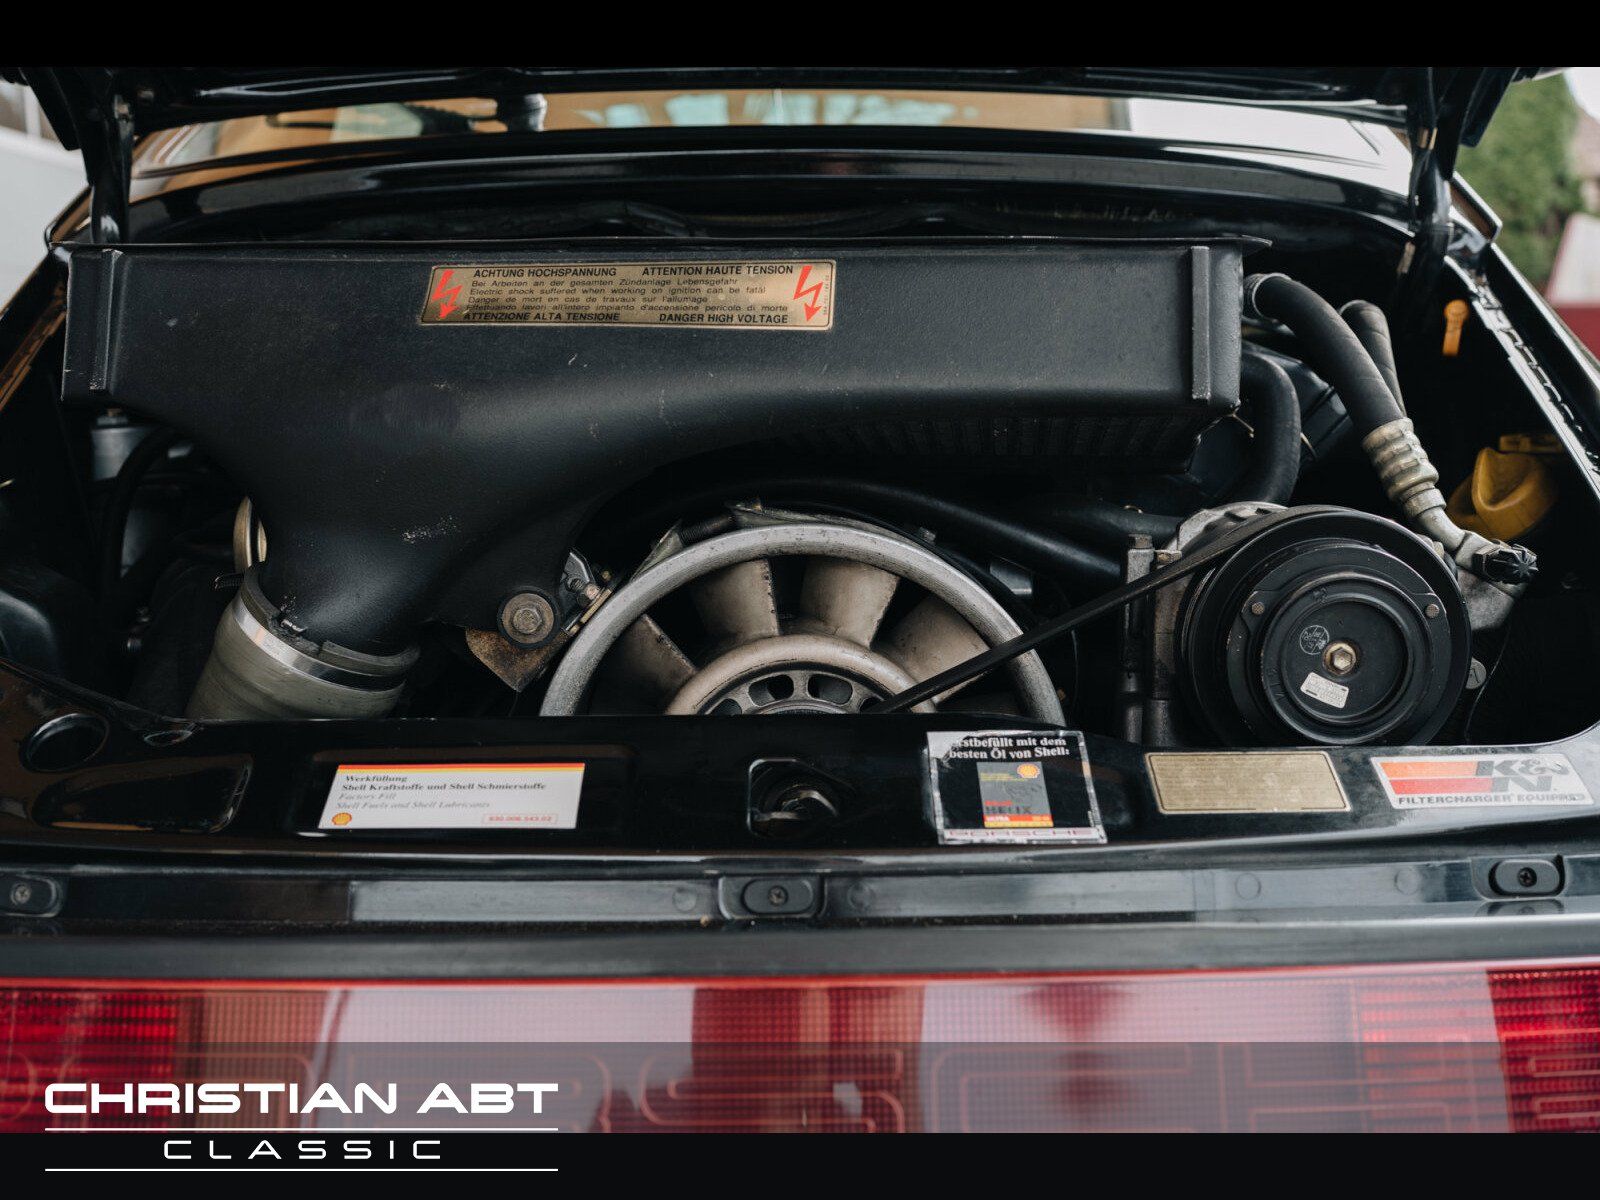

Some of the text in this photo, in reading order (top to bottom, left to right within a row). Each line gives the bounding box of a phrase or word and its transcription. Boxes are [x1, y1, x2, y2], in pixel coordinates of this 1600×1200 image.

[473, 267, 617, 278] ACHTUNG HOCHSPANNUNG
[642, 265, 793, 276] ATTENTION HAUTE TENSION
[550, 279, 565, 287] der
[570, 280, 614, 288] gesamten
[619, 278, 672, 287] Zündanlage
[677, 278, 738, 287] Lebensgefahr
[508, 287, 534, 295] shock
[540, 287, 577, 295] suffered
[611, 286, 646, 295] working
[668, 286, 701, 295] ignition
[729, 286, 740, 294] be
[468, 296, 500, 305] Danger
[586, 295, 597, 303] de
[602, 295, 636, 303] travaux
[595, 304, 635, 312] impianto
[704, 304, 742, 313] pericolo
[746, 304, 757, 312] di
[463, 312, 620, 321] ATTENZIONE ALTA TENSIONE
[659, 313, 788, 324] DANGER HIGH VOLTAGE
[1016, 736, 1037, 746] mit
[1040, 736, 1067, 746] dem
[950, 746, 1070, 759] besten Öl von Shell:
[345, 774, 408, 783] Werkfüllung
[341, 782, 547, 791] Shell Kraftstoffe und Shell Schmierstoffe
[1398, 794, 1512, 805] FILTERCHARGER
[411, 801, 436, 809] Shell
